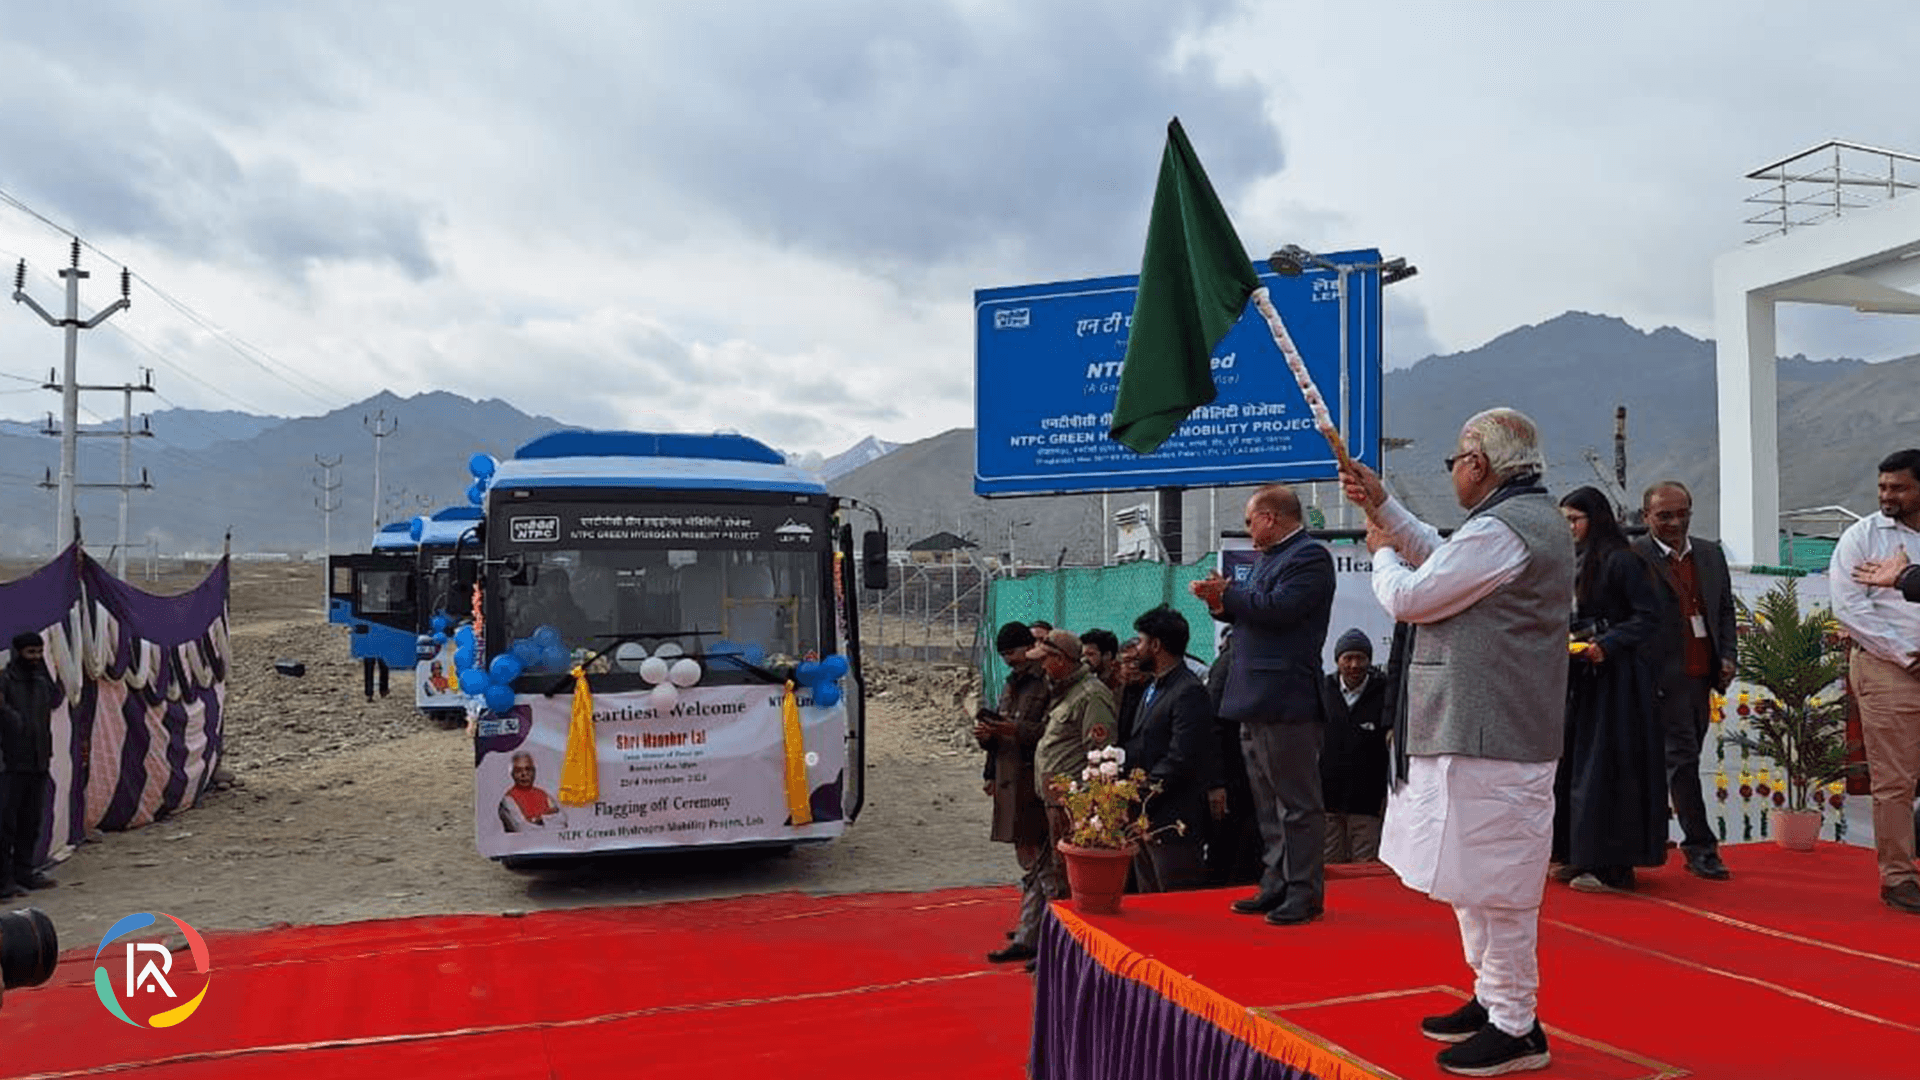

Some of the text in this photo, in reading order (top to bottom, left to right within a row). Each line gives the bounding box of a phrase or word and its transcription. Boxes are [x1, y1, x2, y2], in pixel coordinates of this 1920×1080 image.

[1010, 434, 1046, 447] NTPC
[1049, 431, 1095, 445] GREEN
[1179, 421, 1249, 437] MOBILITY
[516, 529, 554, 539] NTPC
[570, 530, 595, 539] NTPC
[597, 530, 629, 539] GREEN
[591, 701, 747, 722] eartiest Welcome
[616, 734, 640, 750] Shri
[594, 796, 731, 819] Flagging off Ceremony
